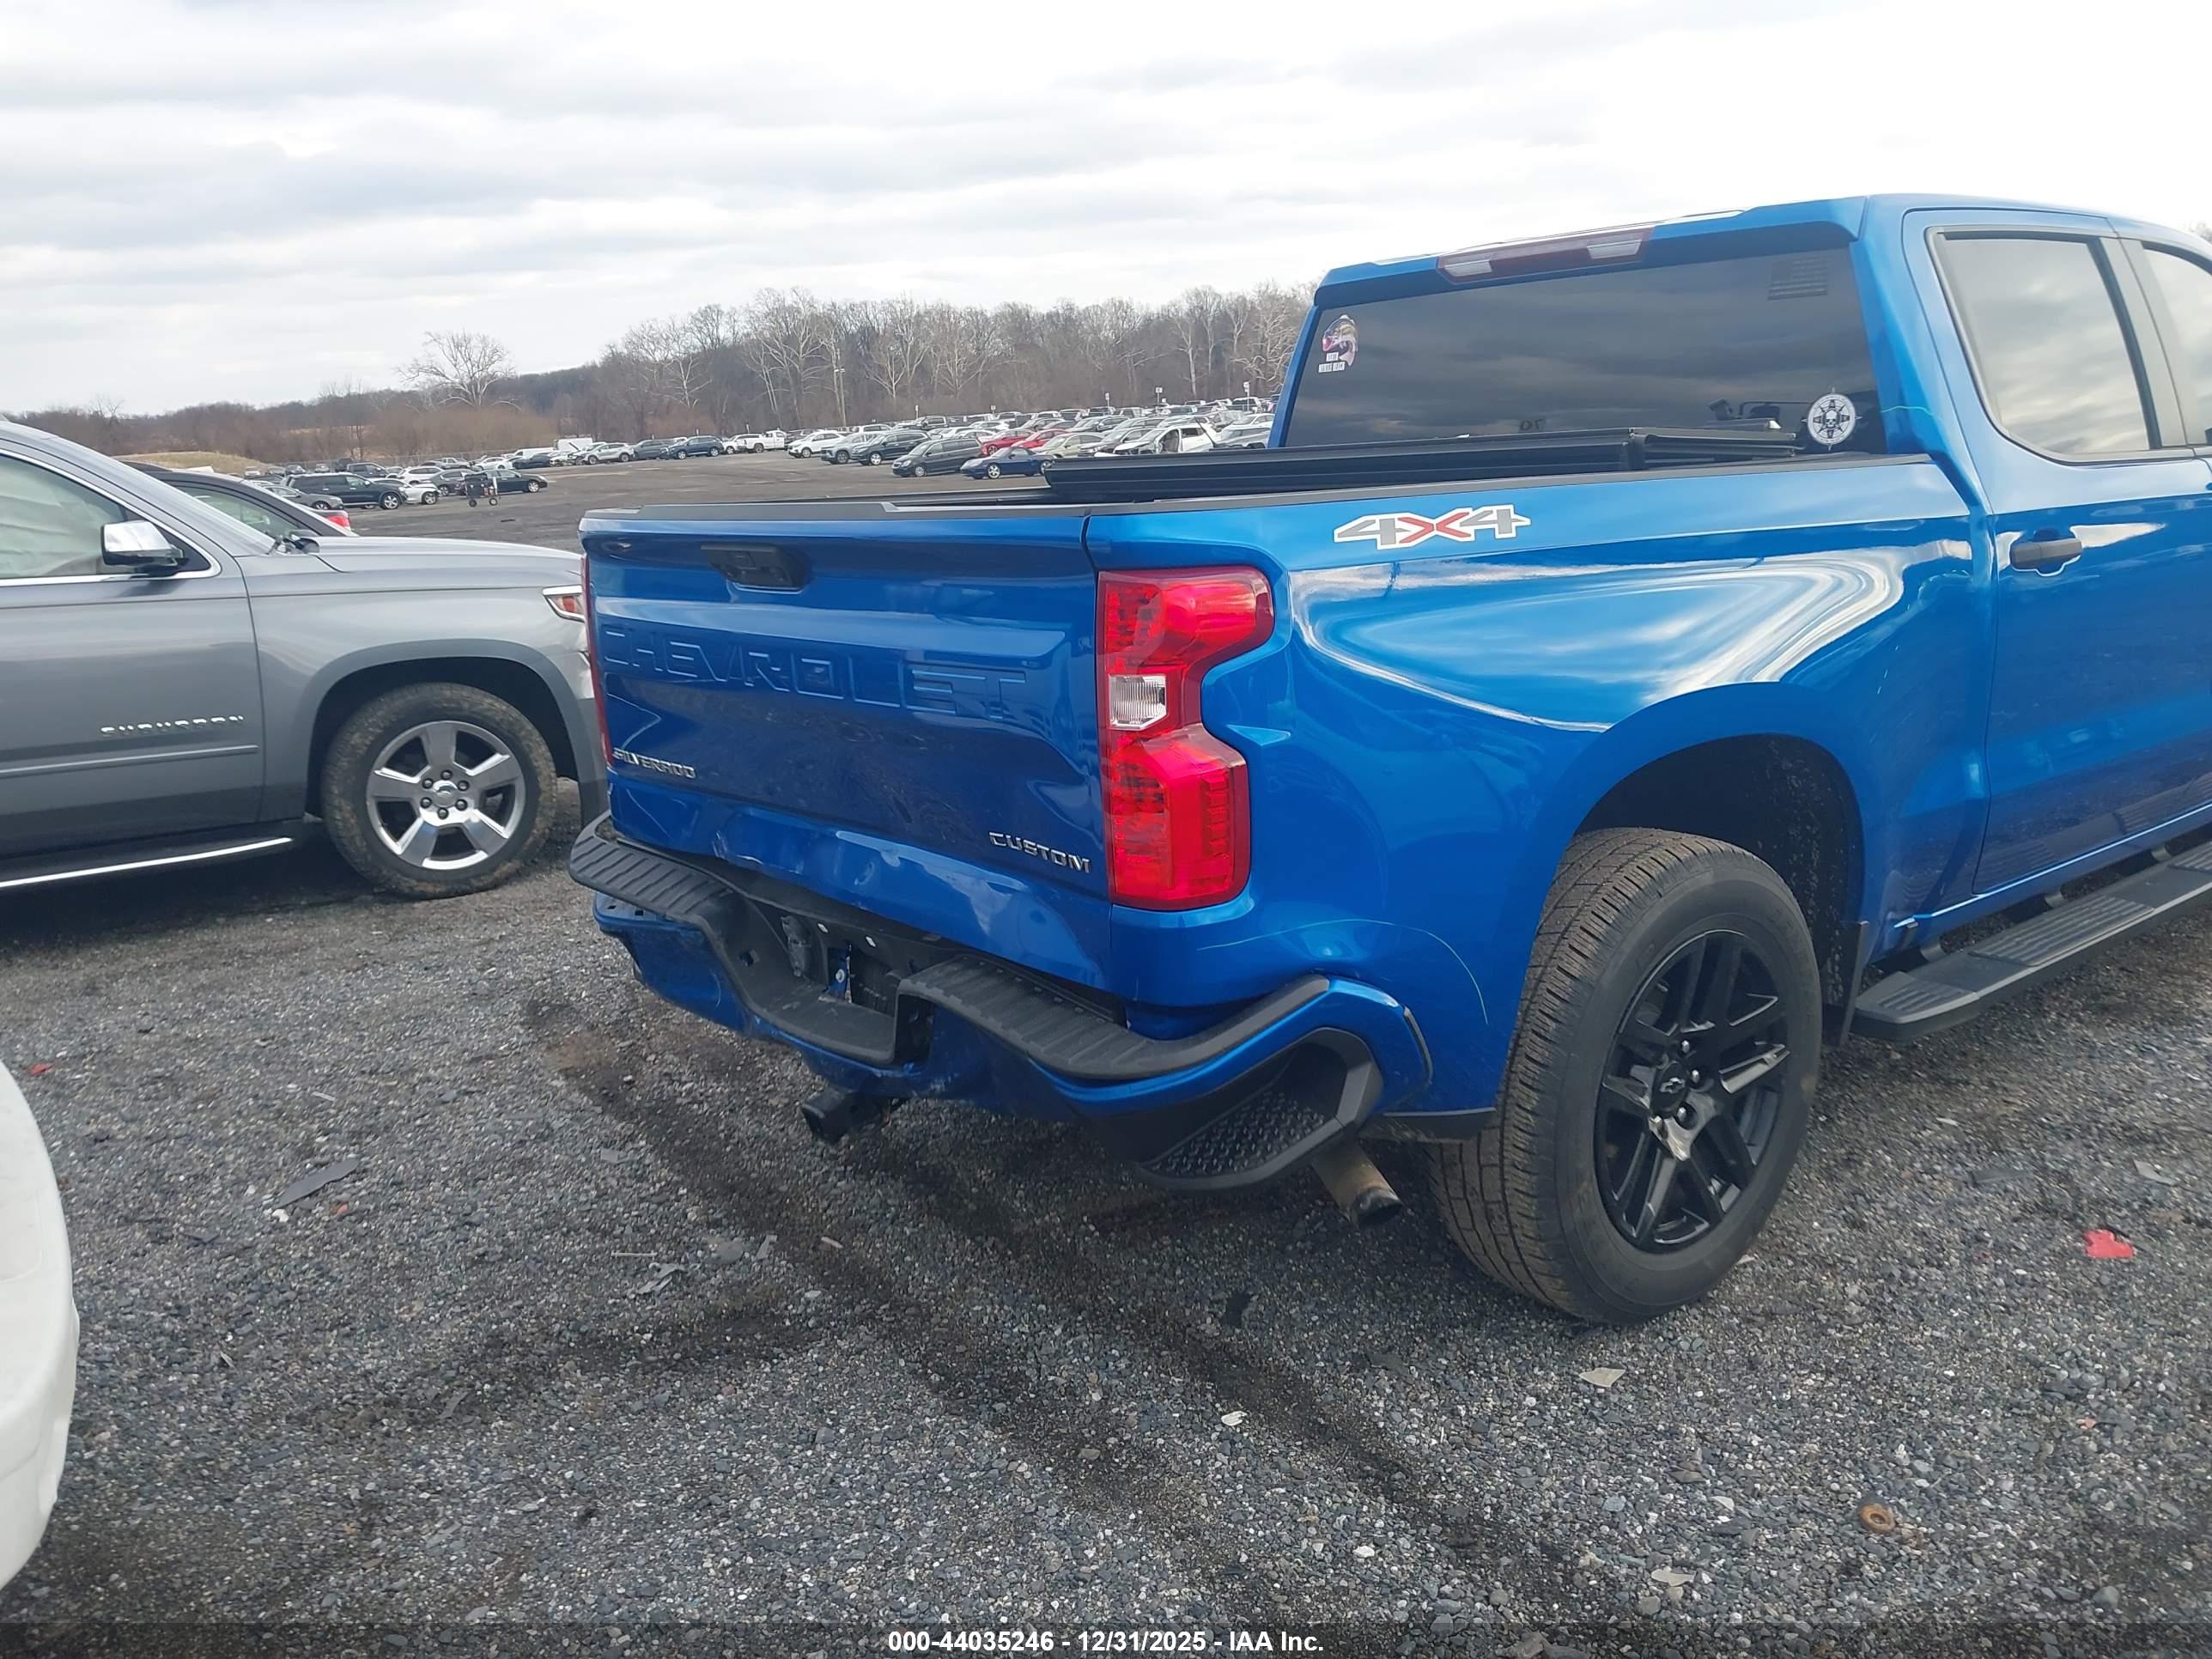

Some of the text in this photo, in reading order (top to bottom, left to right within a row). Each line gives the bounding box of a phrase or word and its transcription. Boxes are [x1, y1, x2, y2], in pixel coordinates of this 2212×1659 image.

[599, 624, 1026, 720] CHEVROLET
[612, 747, 697, 779] SILVERADO
[988, 831, 1091, 873] CUSTOM
